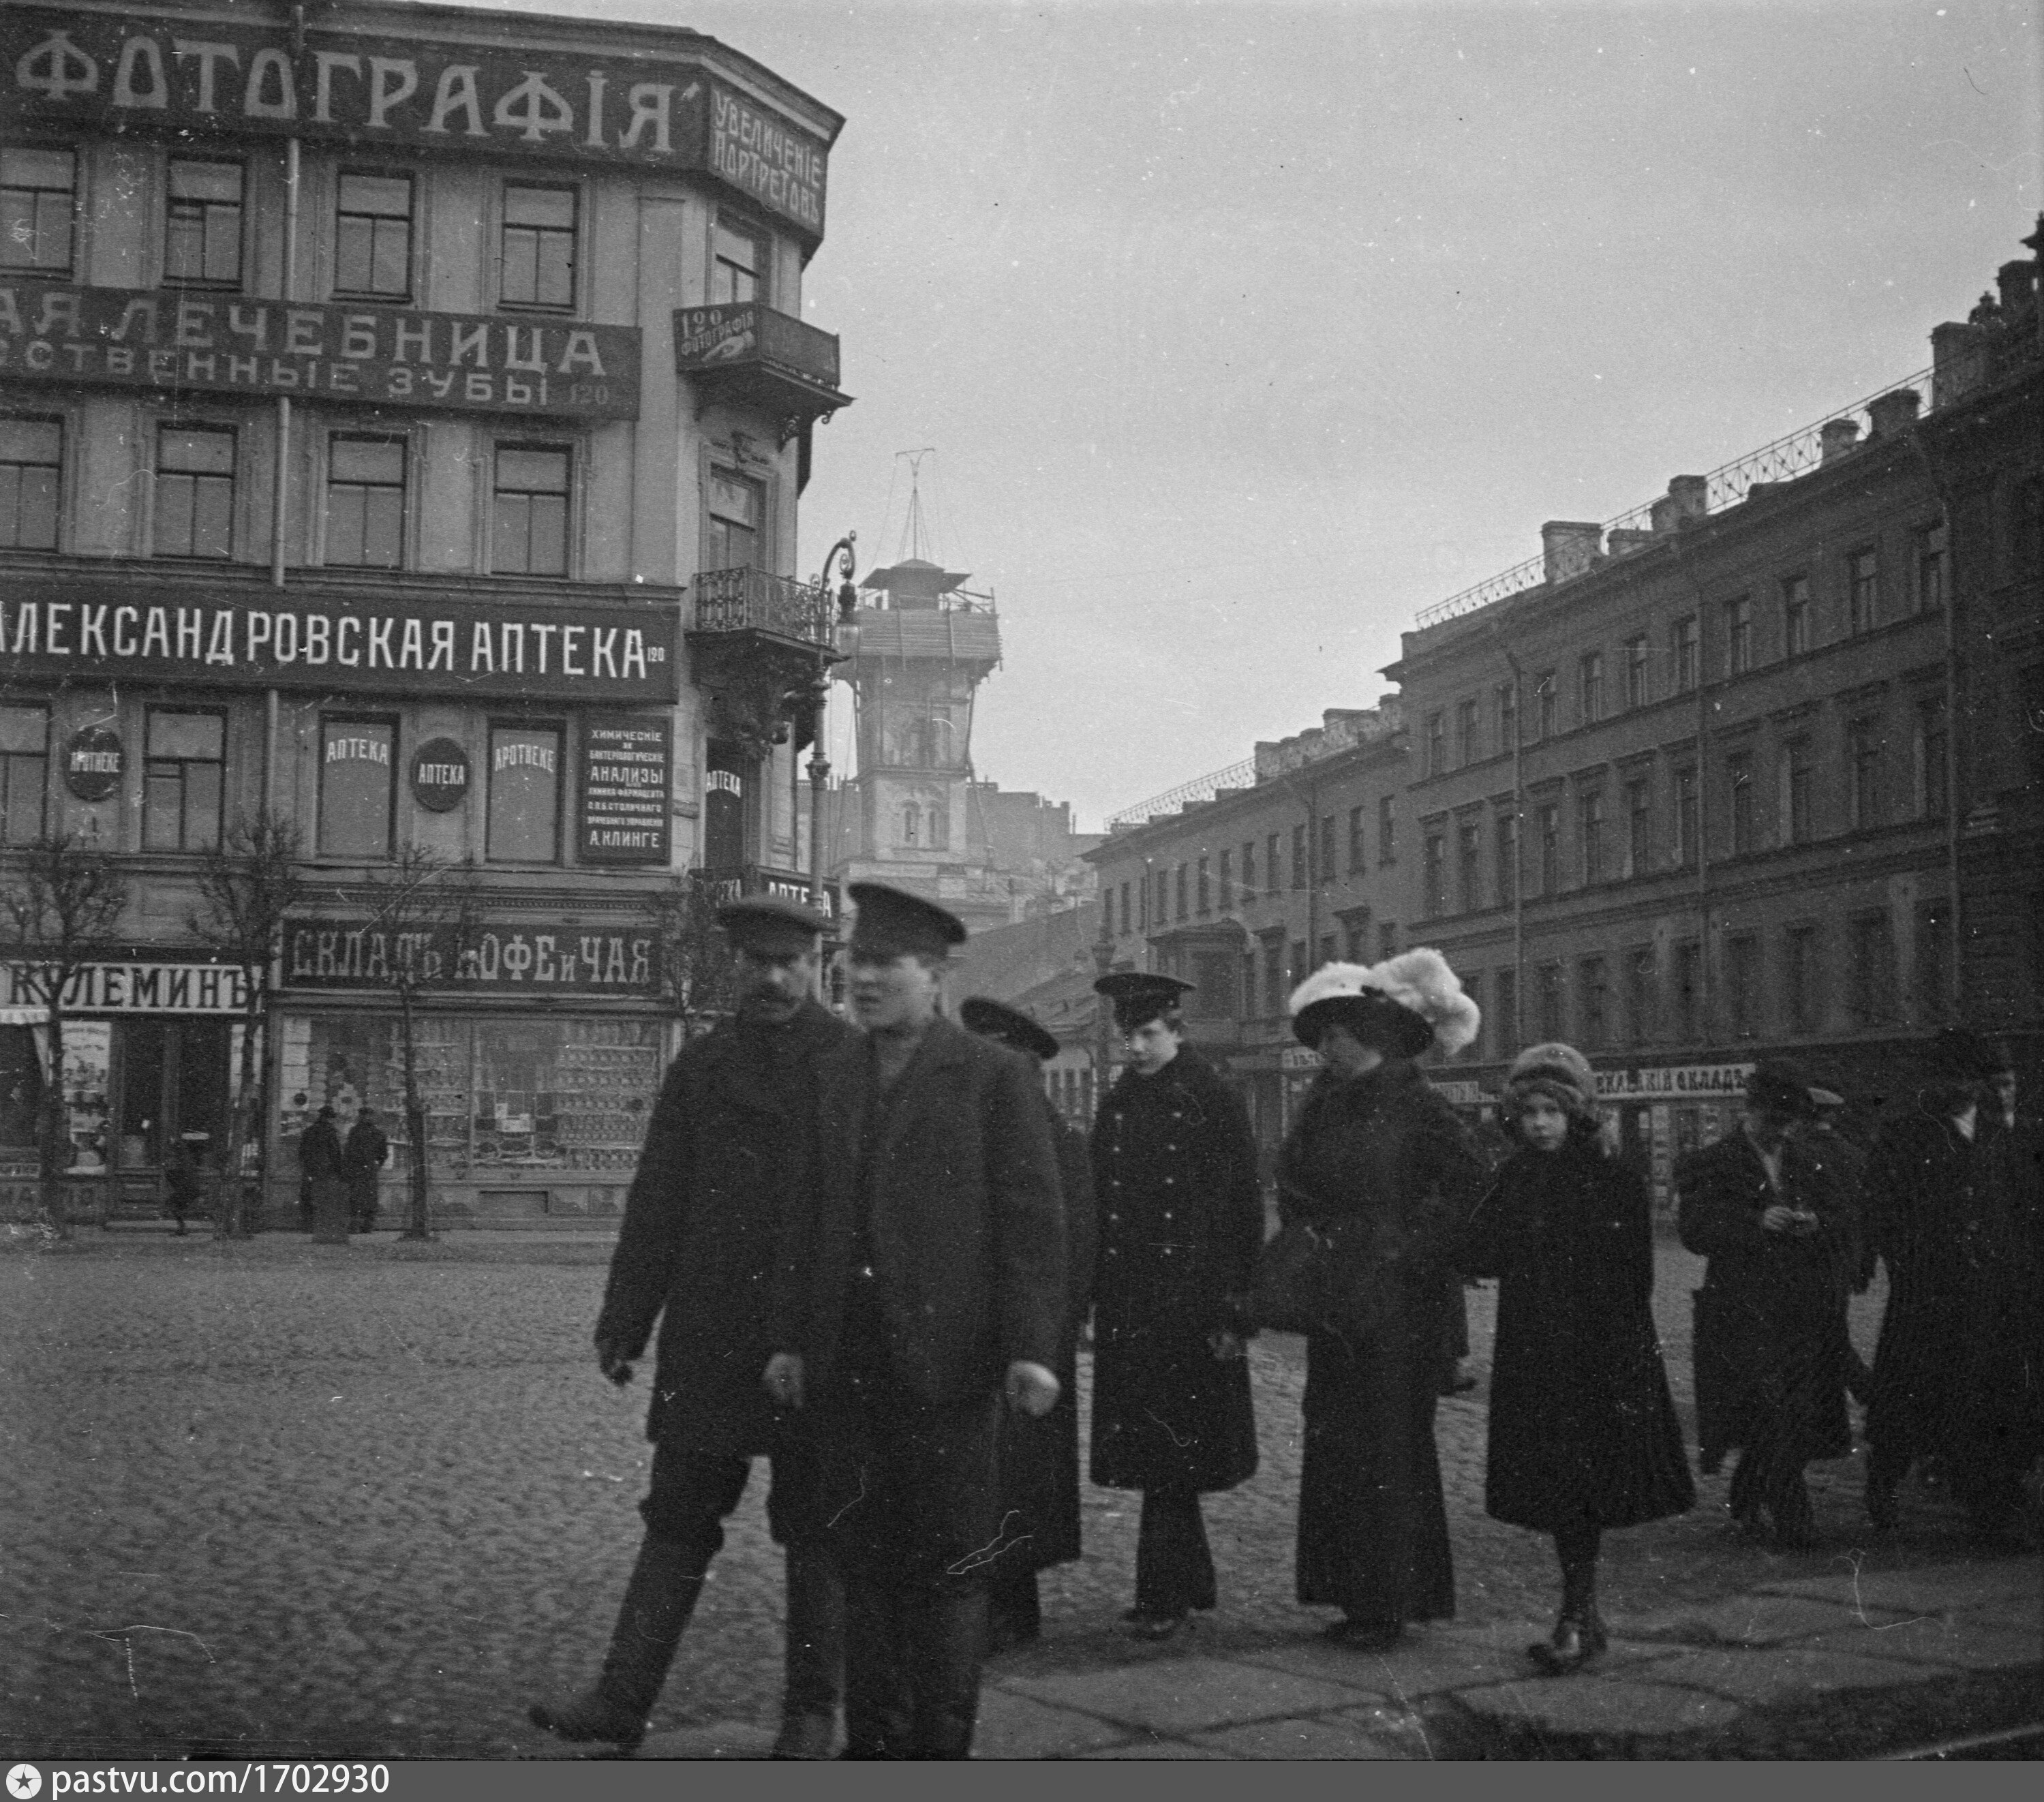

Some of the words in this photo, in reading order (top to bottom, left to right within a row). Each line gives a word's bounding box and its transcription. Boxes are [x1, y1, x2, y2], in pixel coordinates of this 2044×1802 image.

[710, 87, 822, 189] УВЕЛИЧЕНІЕ
[110, 297, 607, 377] ЛЕЧЕБНИЦА
[0, 339, 360, 392] СТВЕННЫЕ
[387, 367, 548, 406] ЗУБЫ
[471, 620, 647, 680] АПТЕКА
[326, 737, 391, 765] АПТЕКА
[591, 729, 662, 742] ХИМИЧЕСКІЕ
[418, 763, 466, 785] АПТЕКА
[590, 765, 664, 784] АНАЛИЗЫ
[768, 881, 833, 919] АПТЕА
[579, 936, 653, 985] ЧАЯ
